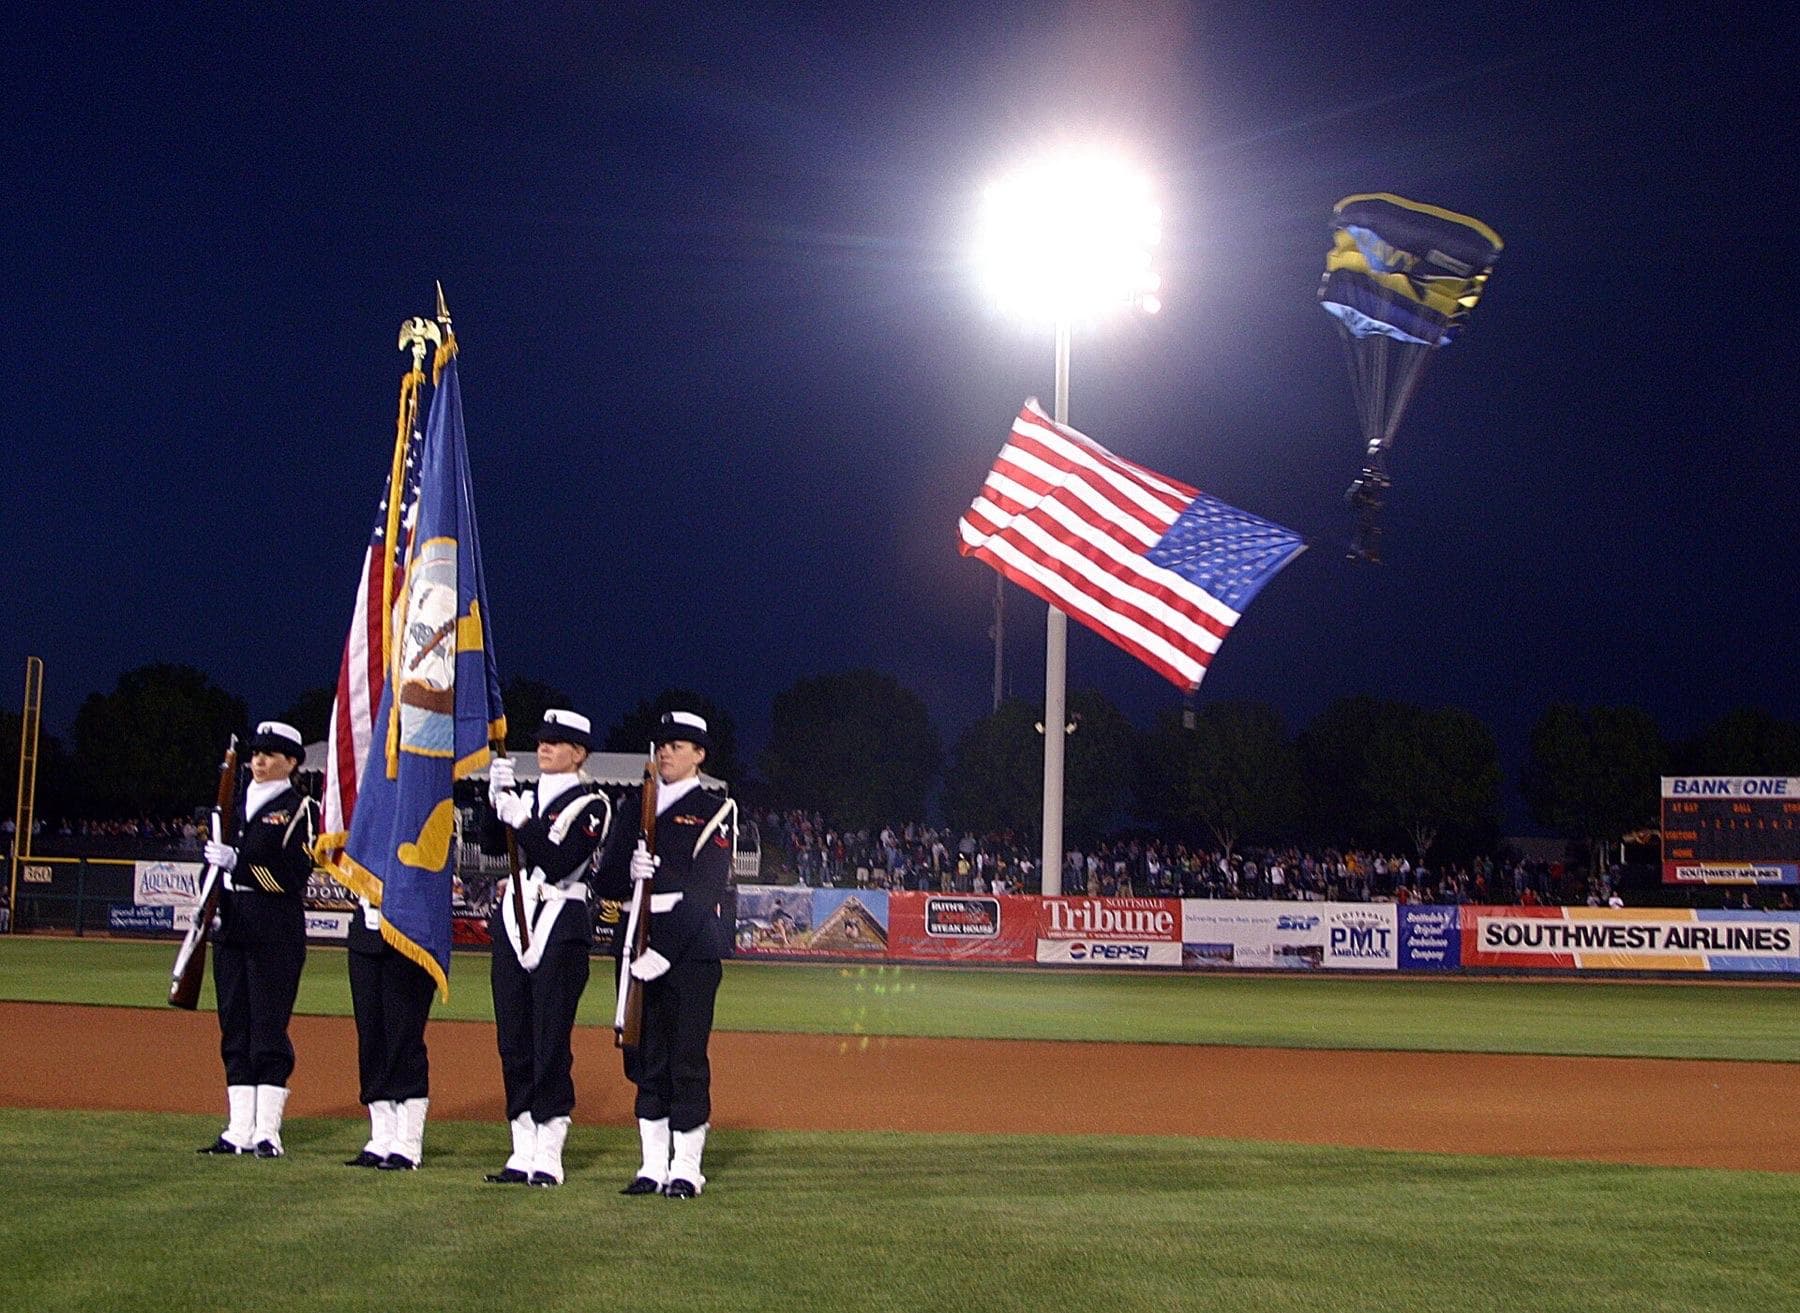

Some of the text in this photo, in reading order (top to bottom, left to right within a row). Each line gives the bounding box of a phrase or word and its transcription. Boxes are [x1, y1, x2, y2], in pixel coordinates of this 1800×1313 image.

[1672, 780, 1788, 795] BANK ONE
[1680, 868, 1778, 878] SOUTHWEST AIRLINES
[142, 871, 197, 896] AQUAFINA
[1106, 899, 1164, 909] SCOTTSDALE
[1042, 899, 1174, 934] Tribune
[305, 919, 339, 930] EPSI
[1331, 928, 1391, 950] PMT
[1485, 924, 1790, 951] SOUTHWEST AIRLINES
[1091, 944, 1149, 960] PEPSI
[1331, 948, 1391, 957] AMBULANCE
